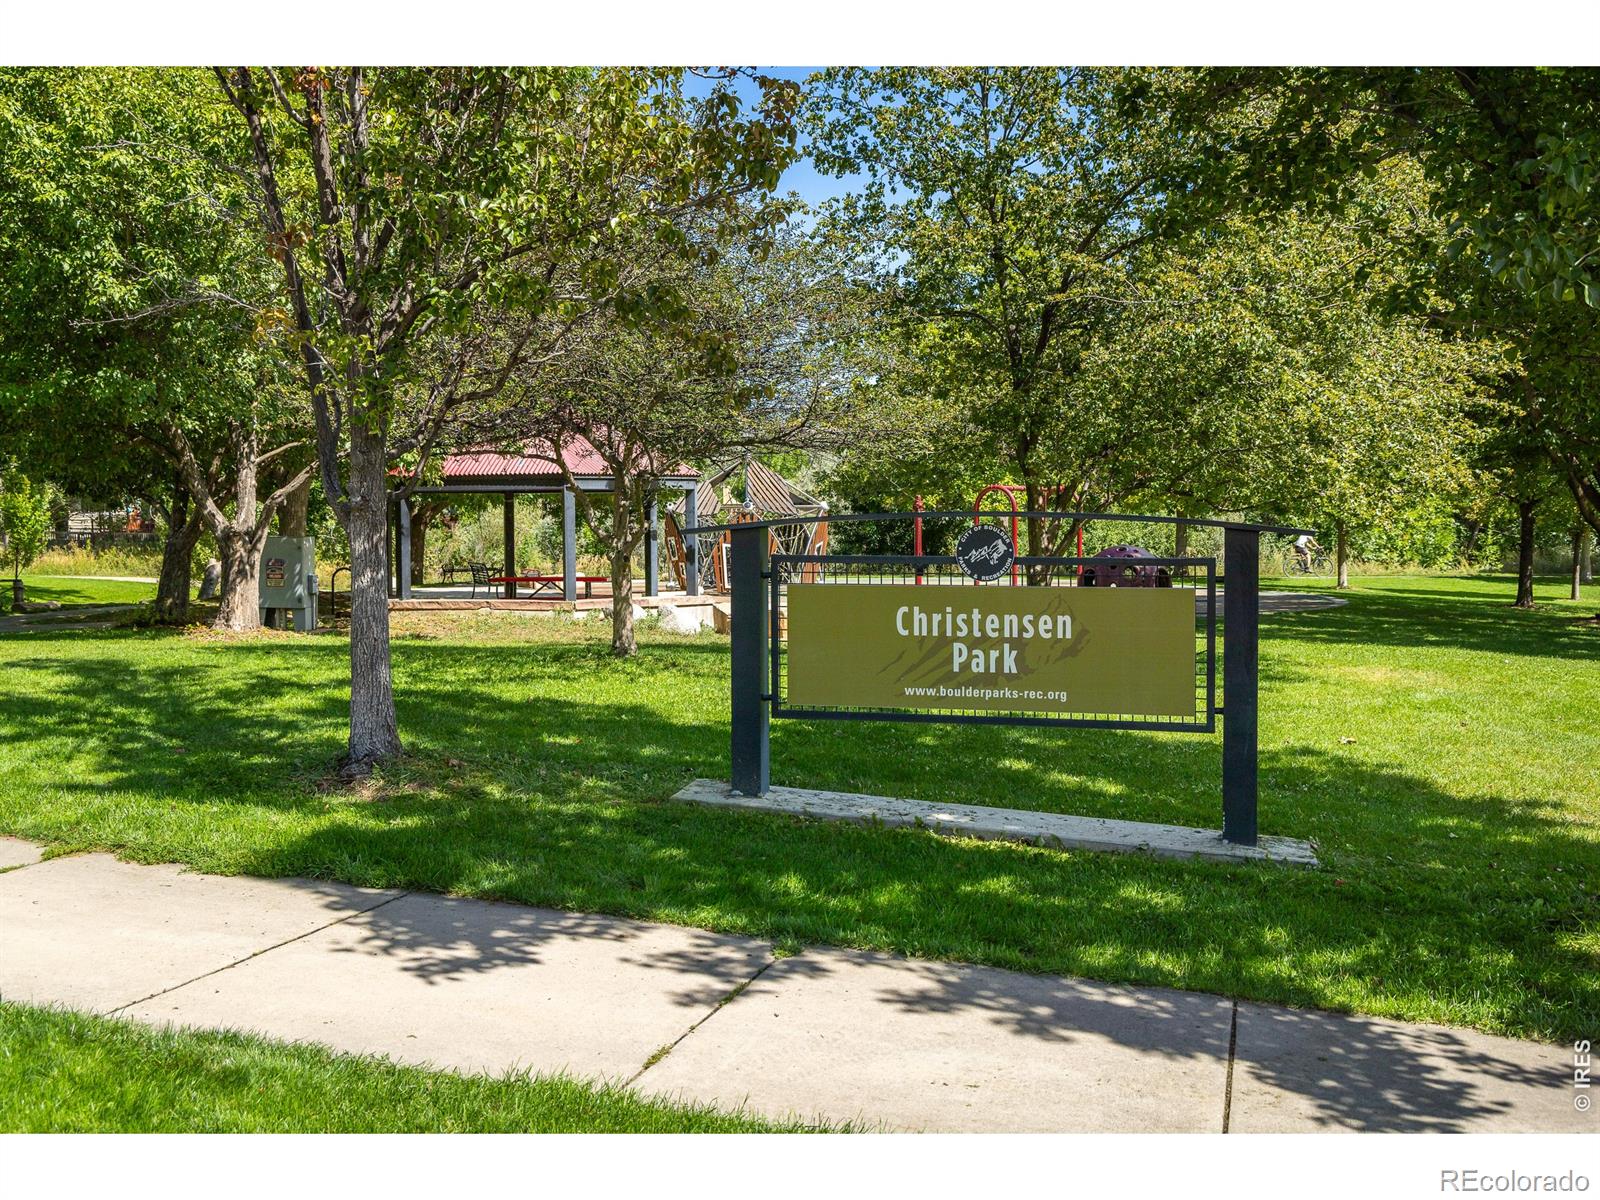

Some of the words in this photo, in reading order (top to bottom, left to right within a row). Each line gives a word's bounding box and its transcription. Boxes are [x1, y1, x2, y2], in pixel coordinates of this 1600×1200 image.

[961, 530, 973, 543] CITY
[983, 525, 1011, 544] BOULDER
[958, 556, 971, 575] PARKS
[981, 557, 1012, 581] RECREATION
[895, 606, 1073, 639] Christensen
[952, 642, 1019, 675] Park
[904, 684, 1068, 703] www.boulderparks-rec.org
